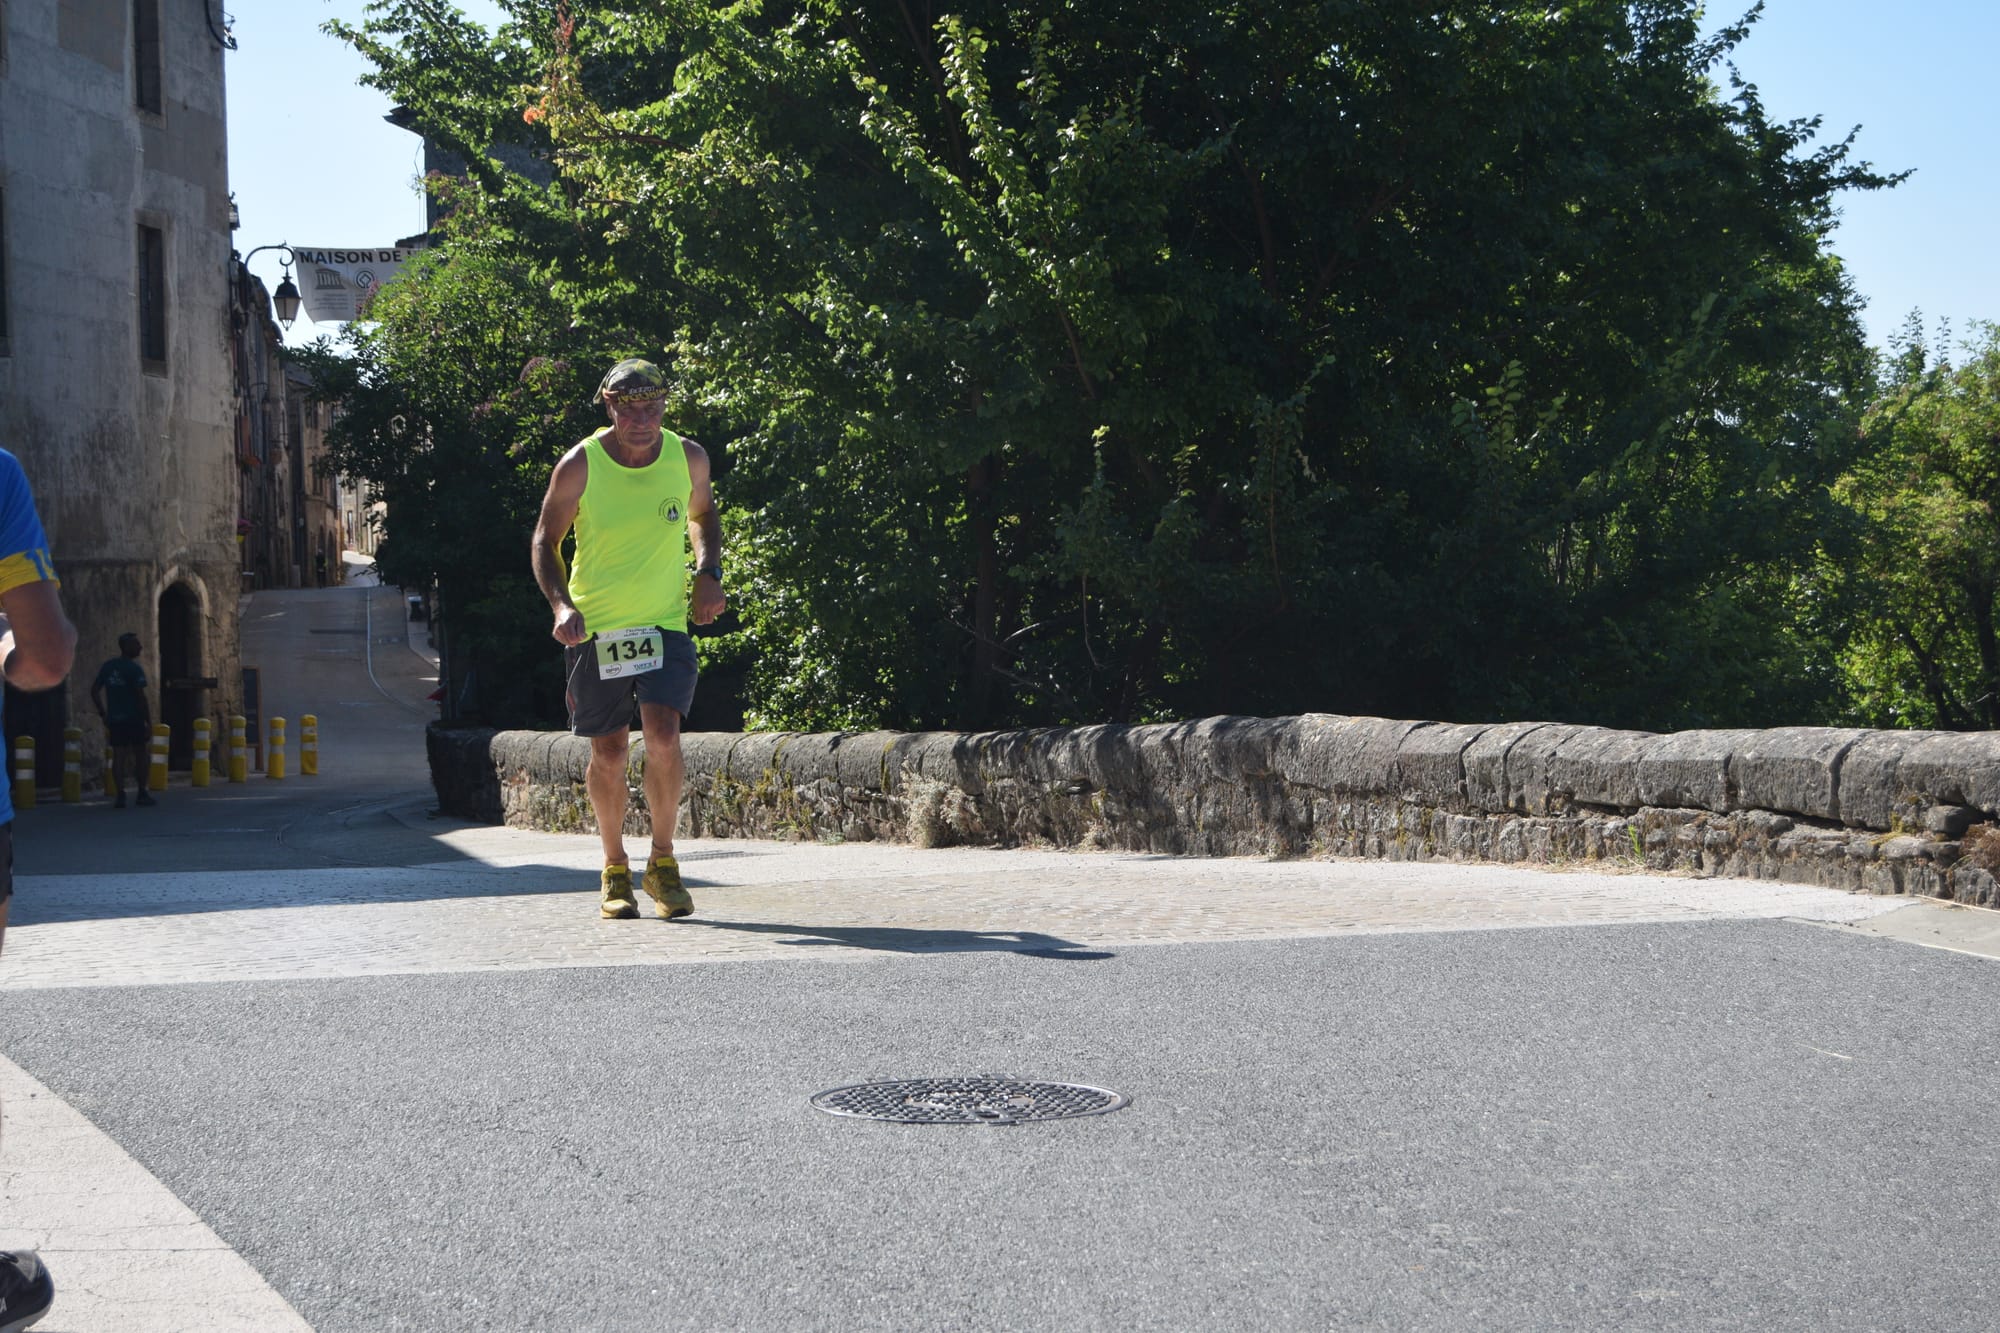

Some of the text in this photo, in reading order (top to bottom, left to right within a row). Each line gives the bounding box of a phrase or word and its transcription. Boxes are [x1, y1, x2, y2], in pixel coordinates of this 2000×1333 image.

[300, 251, 373, 264] MAISON
[379, 250, 402, 262] DE
[606, 638, 655, 661] 134
